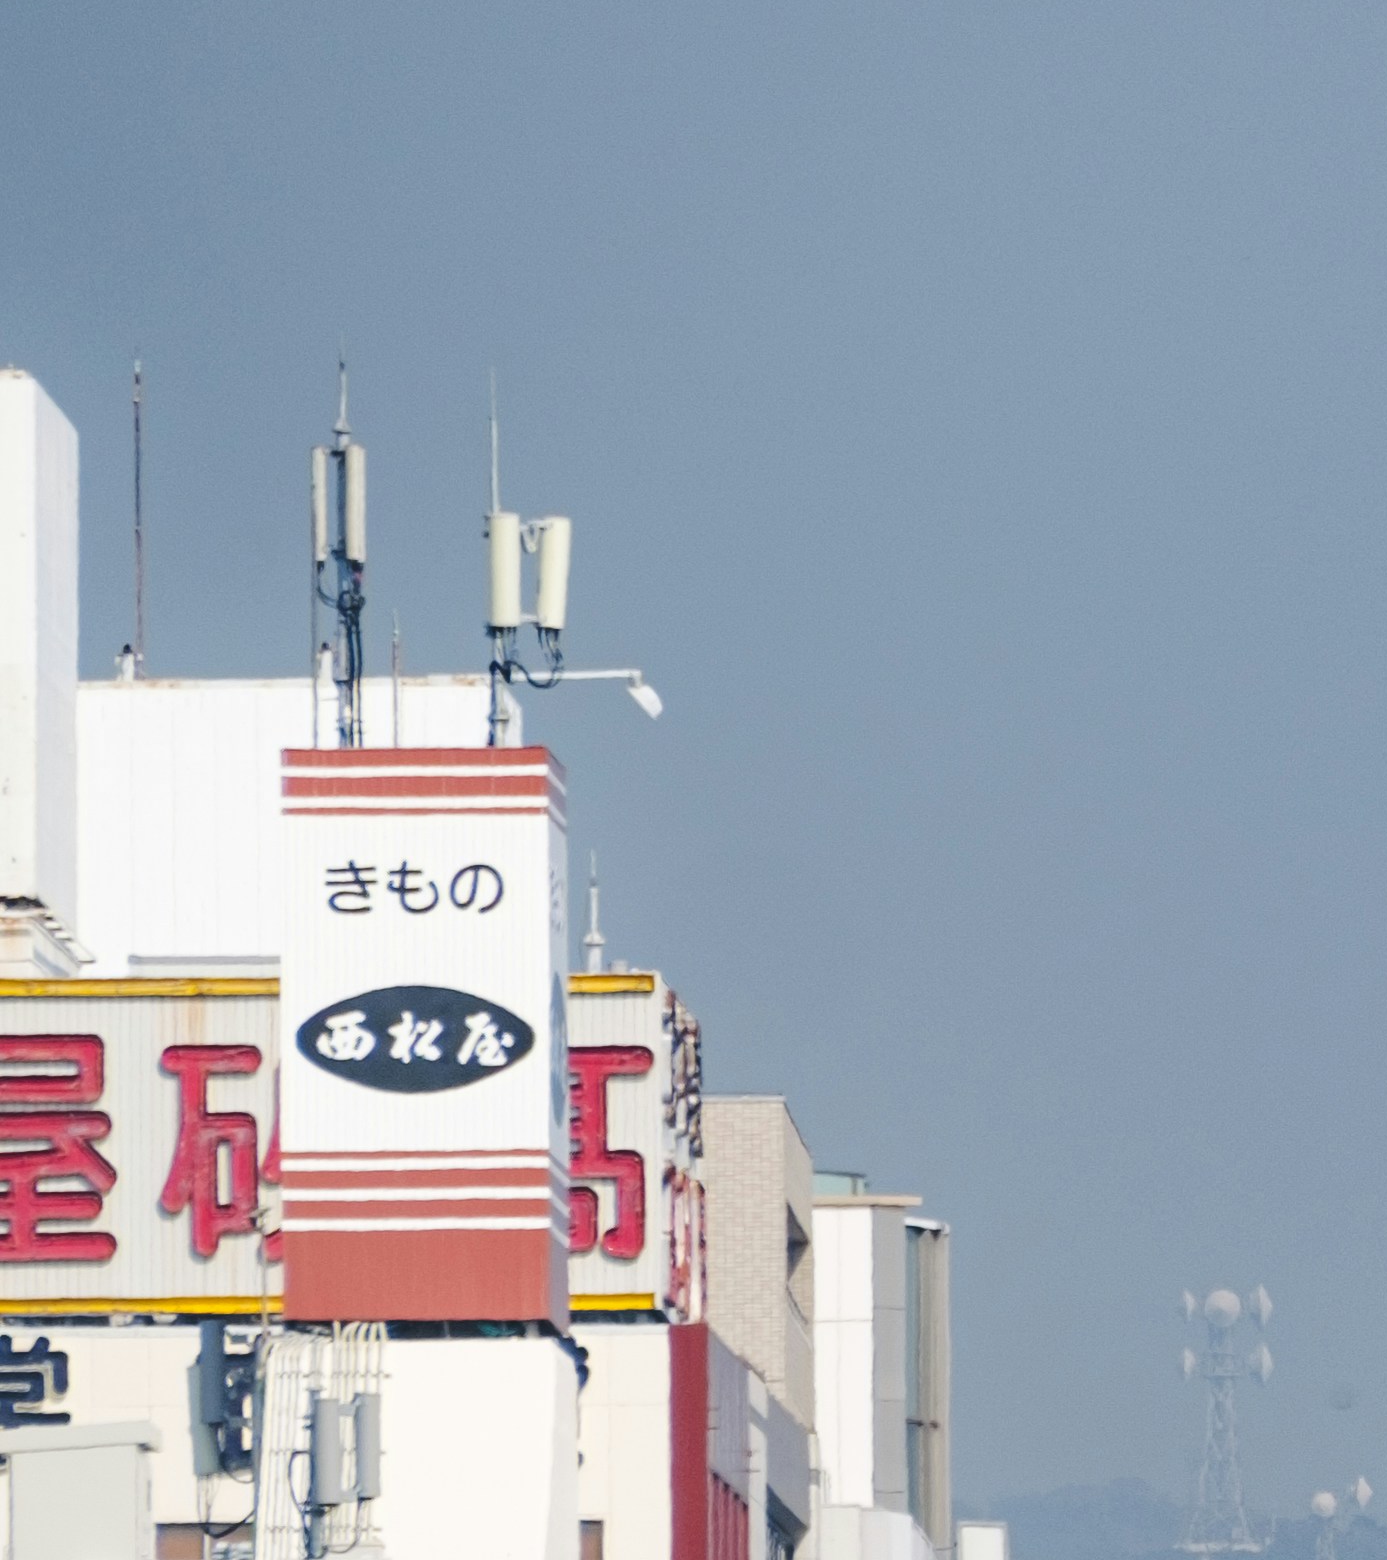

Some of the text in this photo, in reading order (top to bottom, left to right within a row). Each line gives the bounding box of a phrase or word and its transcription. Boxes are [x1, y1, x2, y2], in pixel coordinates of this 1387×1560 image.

[324, 859, 504, 914] きもの
[316, 1010, 516, 1067] 西松屋
